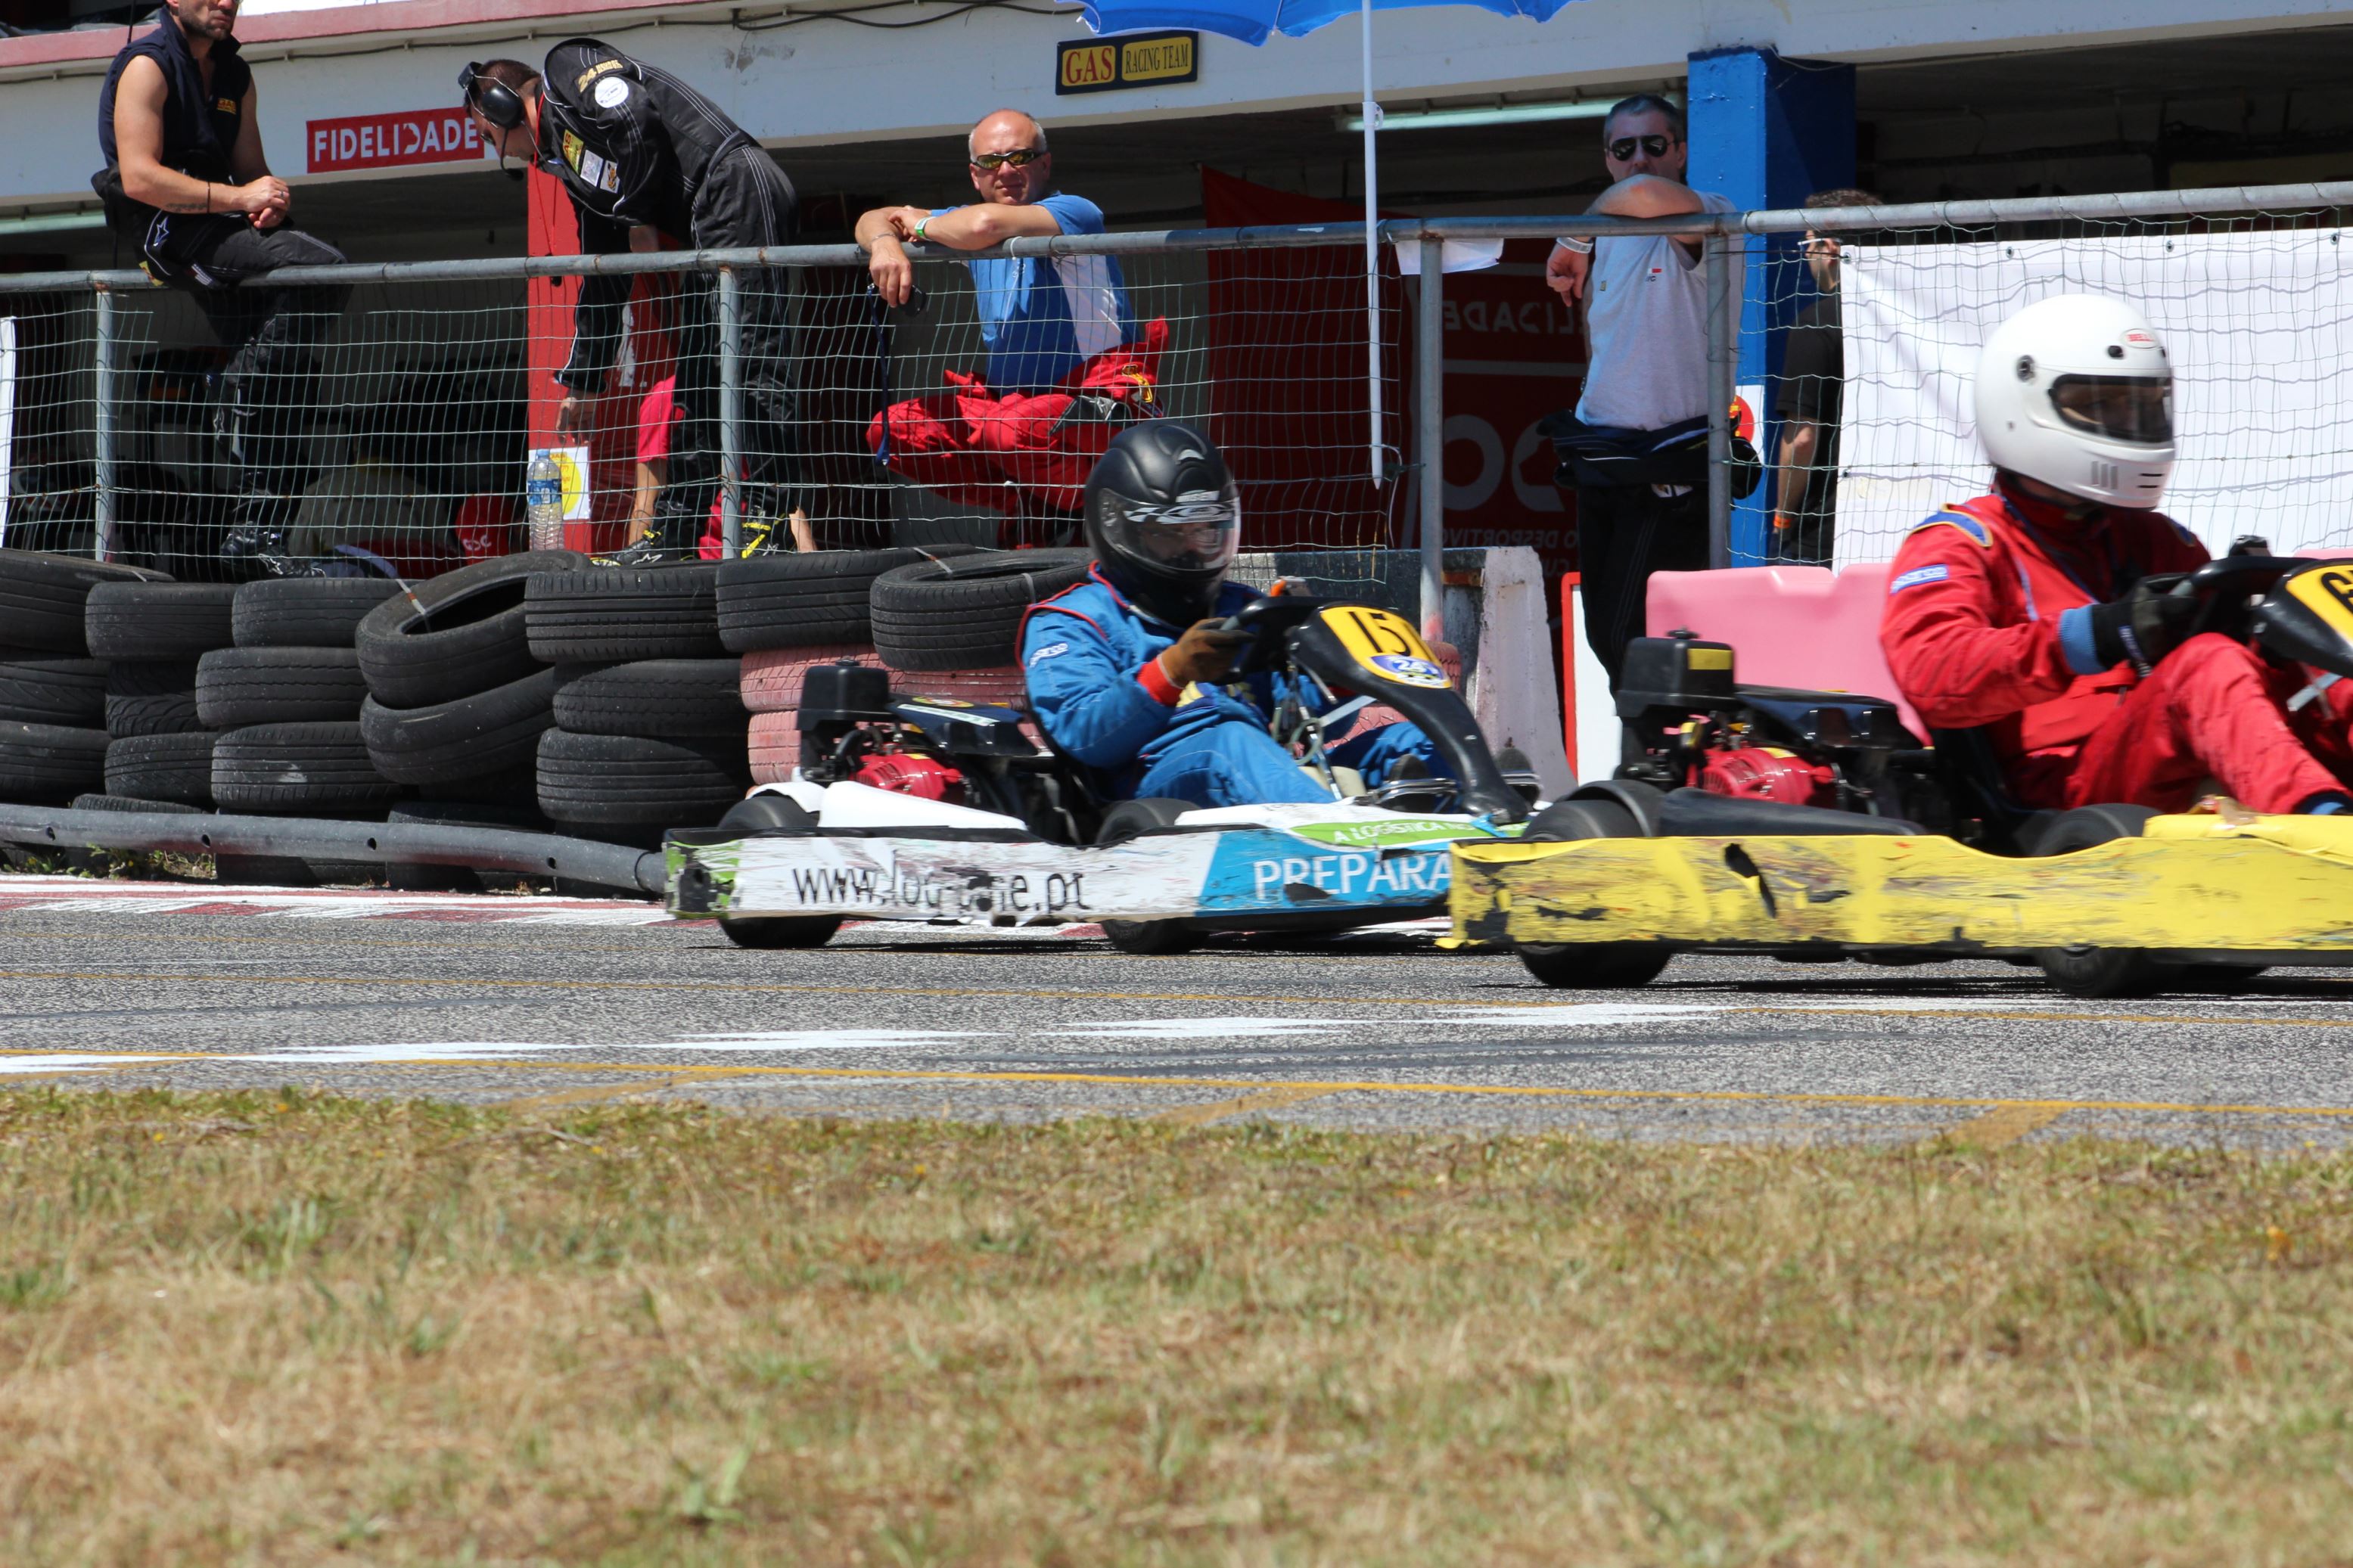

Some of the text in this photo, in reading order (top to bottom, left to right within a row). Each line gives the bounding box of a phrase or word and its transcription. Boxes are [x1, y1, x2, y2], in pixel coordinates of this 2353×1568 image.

[1065, 47, 1112, 85] GAS
[1125, 43, 1189, 74] RACING TEAM
[314, 117, 478, 162] FIDELIDADE
